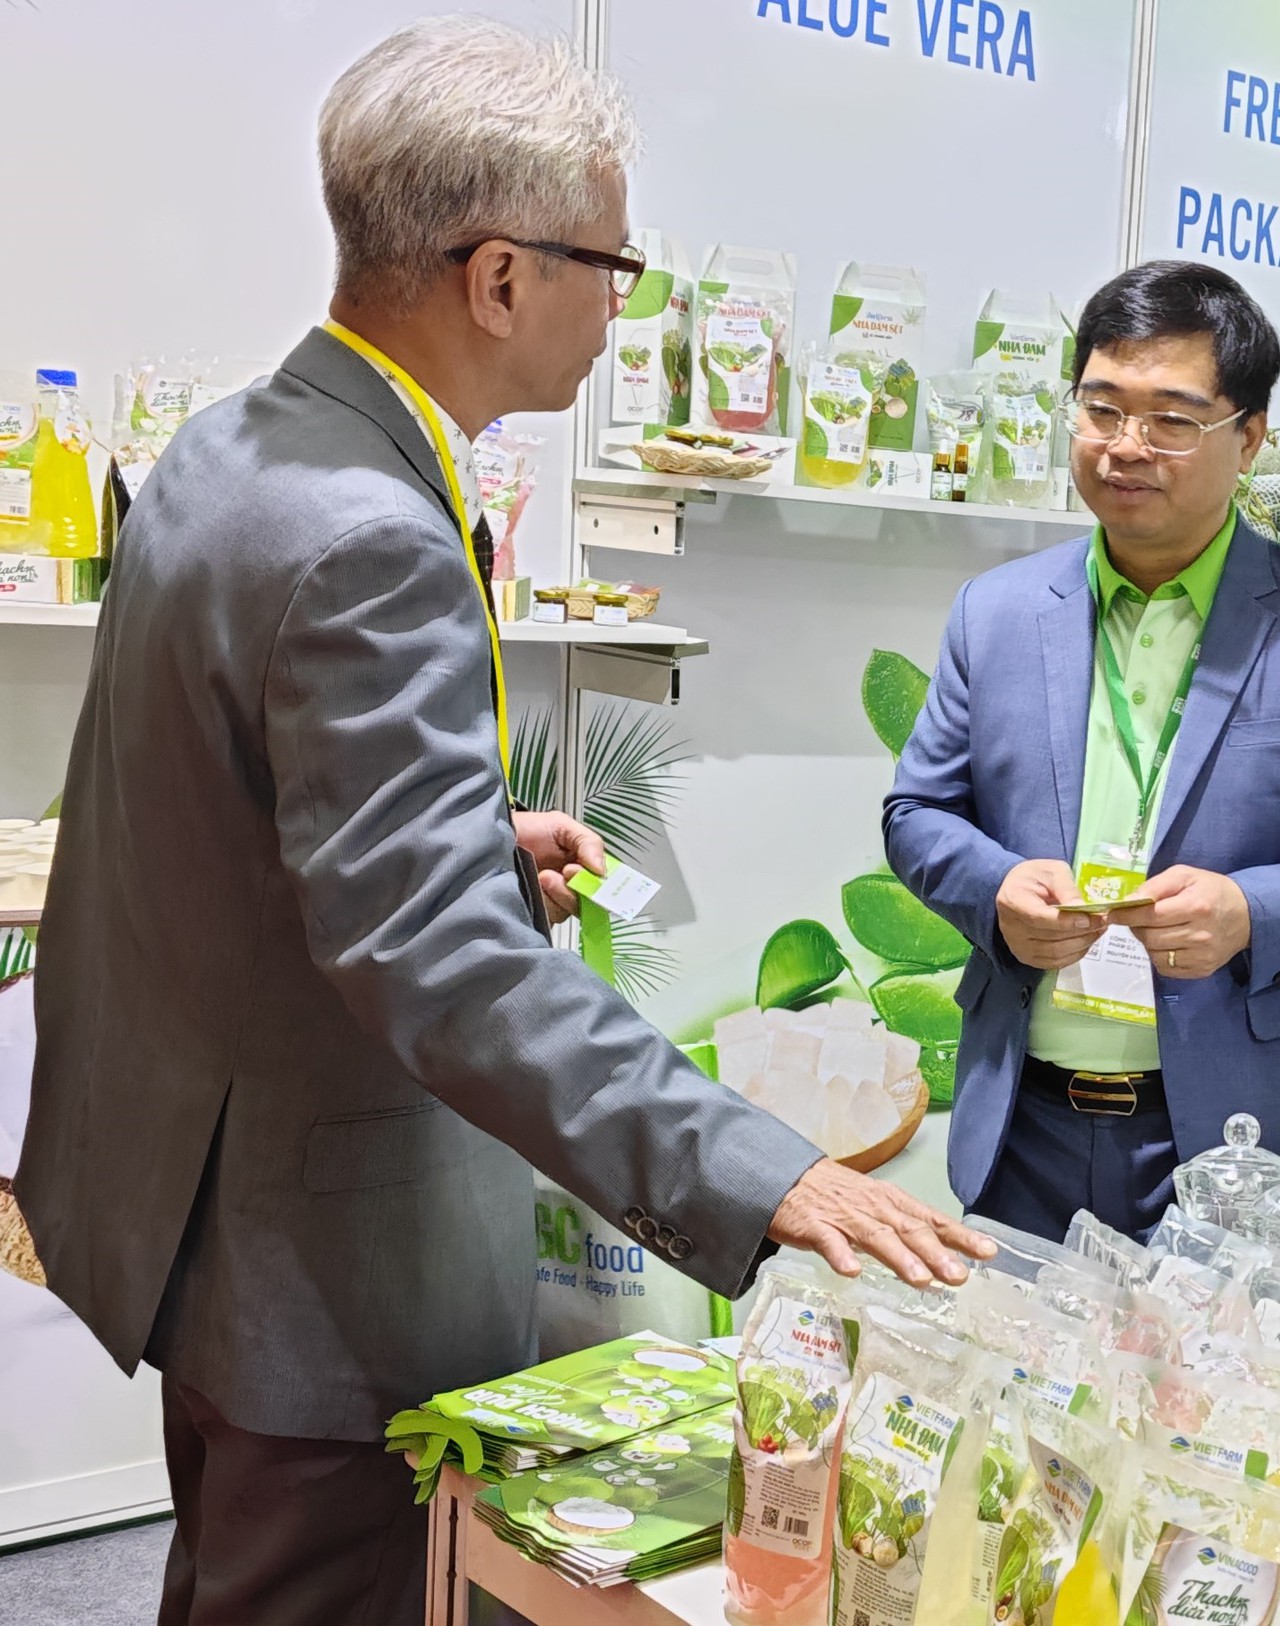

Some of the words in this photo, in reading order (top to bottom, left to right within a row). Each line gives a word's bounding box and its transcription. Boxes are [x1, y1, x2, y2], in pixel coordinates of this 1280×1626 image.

[757, 0, 890, 47] LOE
[917, 0, 1036, 82] VERA
[999, 340, 1022, 354] NHA
[585, 1233, 644, 1273] food
[536, 1266, 551, 1282] afe
[554, 1268, 577, 1287] Food
[586, 1275, 618, 1298] Happy
[621, 1281, 646, 1297] Life
[1030, 1373, 1074, 1397] VIETFARM
[885, 1410, 919, 1442] NHA
[916, 1402, 956, 1428] VIETFARM
[1193, 1440, 1244, 1464] VIETFARM
[1218, 1552, 1259, 1576] VINACOCO
